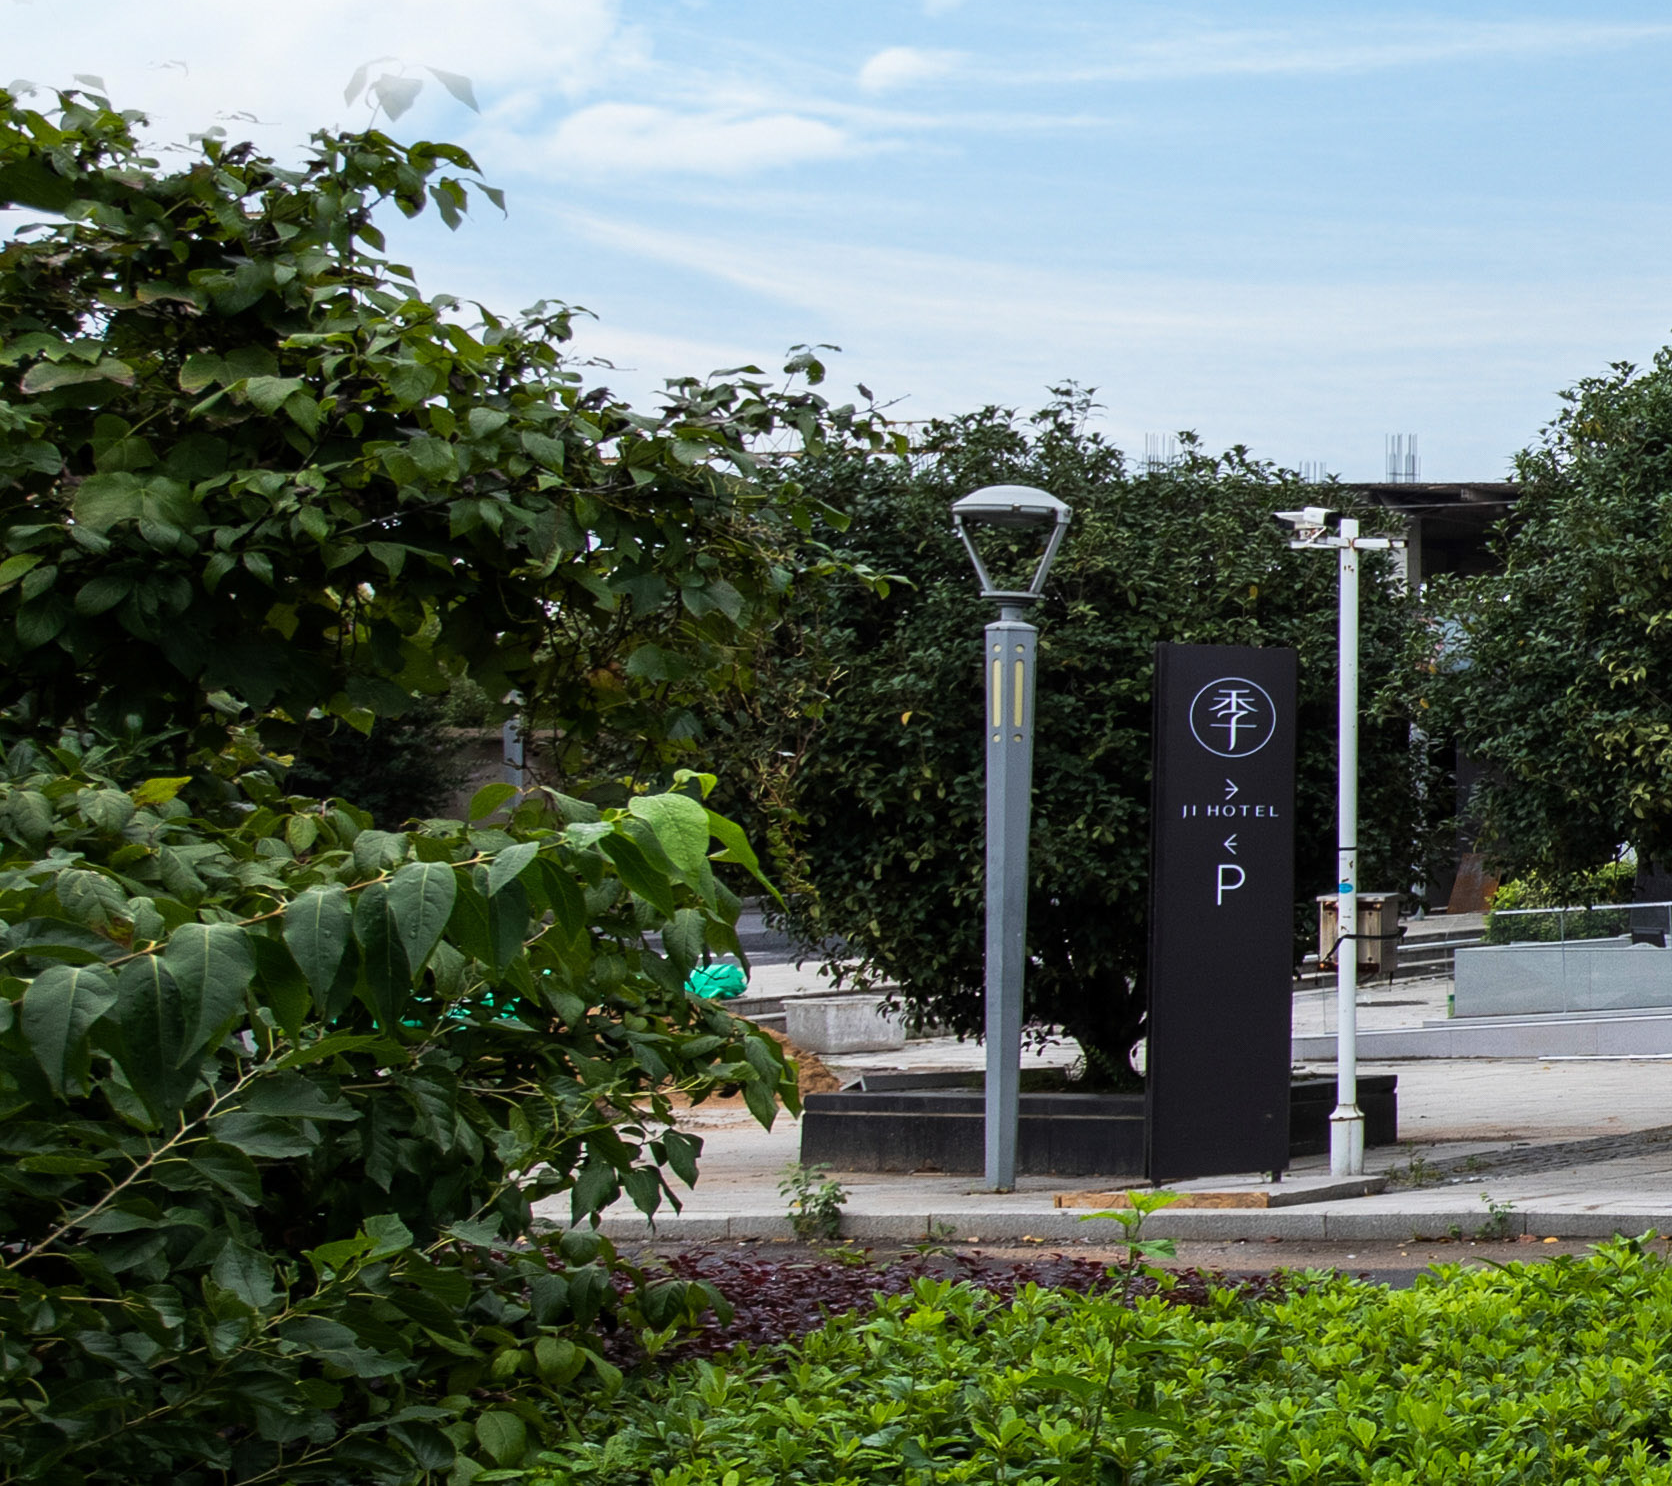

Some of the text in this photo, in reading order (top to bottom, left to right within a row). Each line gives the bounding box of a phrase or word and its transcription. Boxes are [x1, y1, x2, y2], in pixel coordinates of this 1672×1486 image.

[1208, 689, 1259, 751] 季
[1182, 804, 1279, 819] JI HOTEL
[1216, 863, 1246, 907] P
